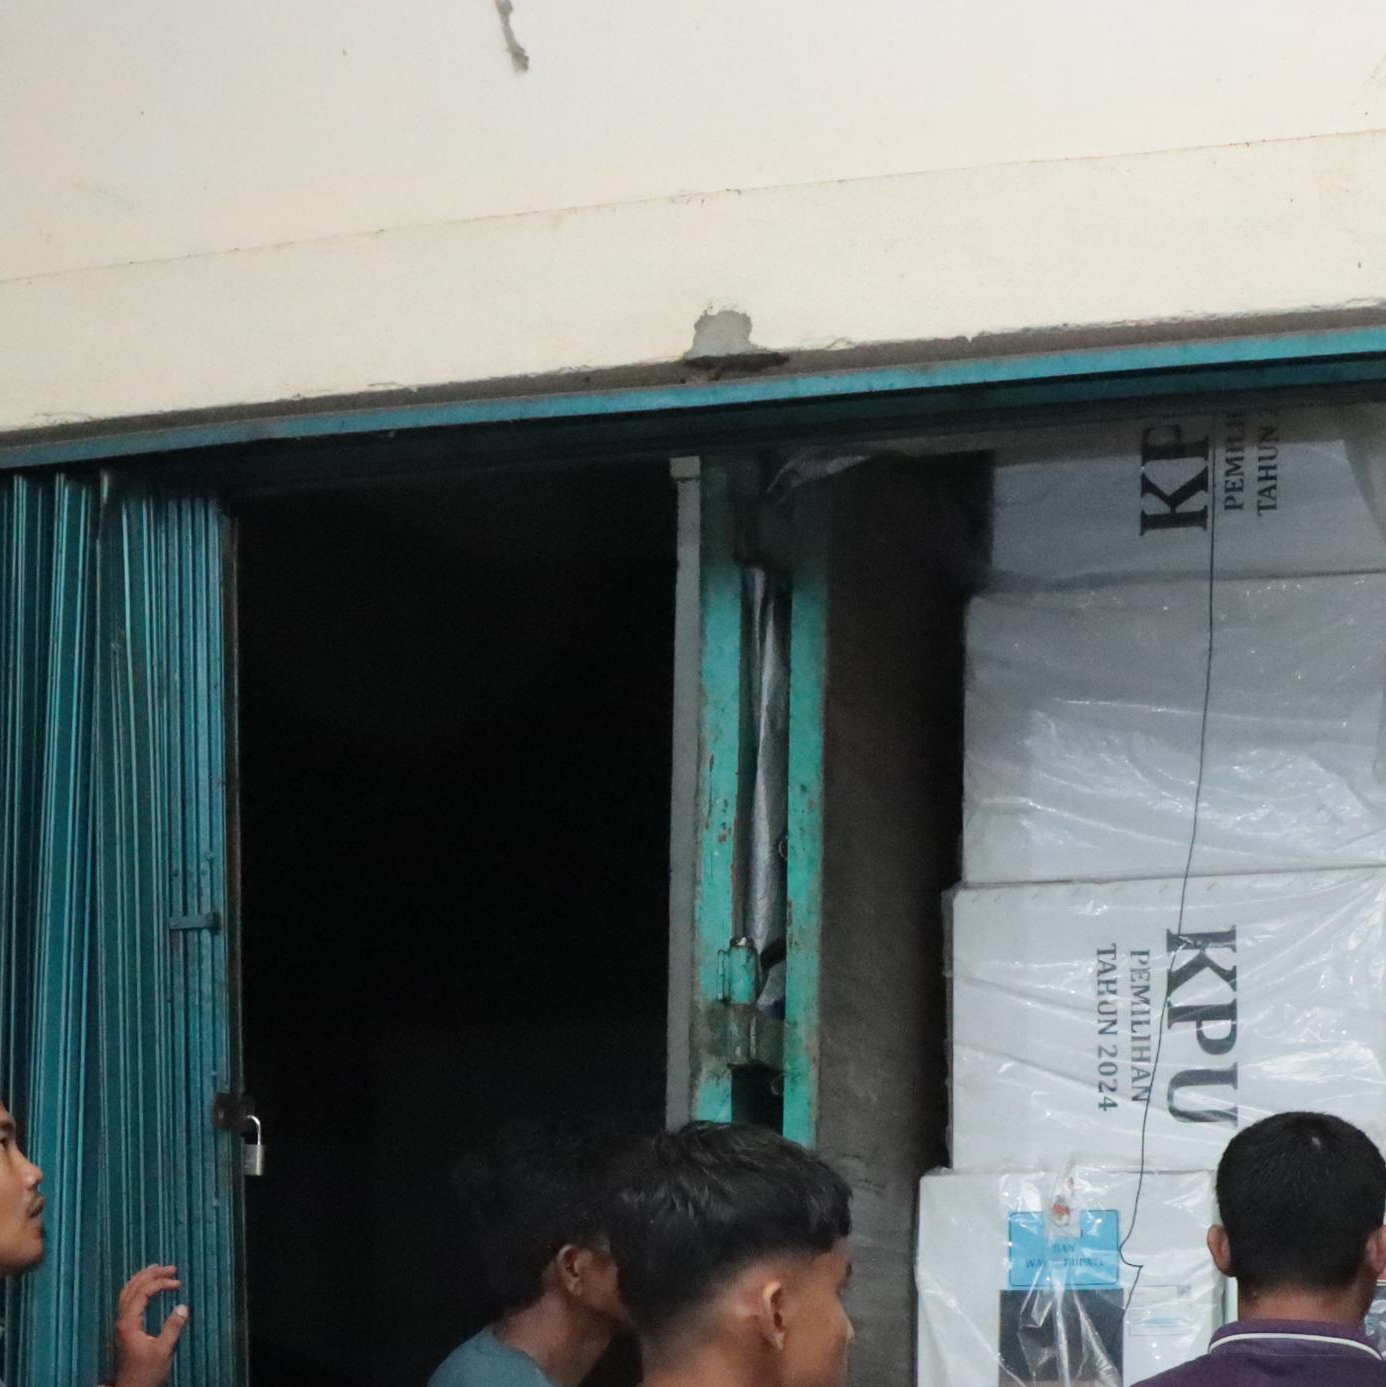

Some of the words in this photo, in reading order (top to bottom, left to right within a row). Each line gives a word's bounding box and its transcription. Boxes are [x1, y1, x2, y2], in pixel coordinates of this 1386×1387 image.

[1139, 424, 1209, 536] KP
[1224, 412, 1245, 512] PEMILI
[1257, 426, 1279, 517] TAHUN
[1097, 943, 1117, 1036] TAHUN
[1130, 949, 1152, 1103] PEMILIHAN
[1166, 924, 1238, 1128] KPU
[1097, 1044, 1119, 1112] 2024
